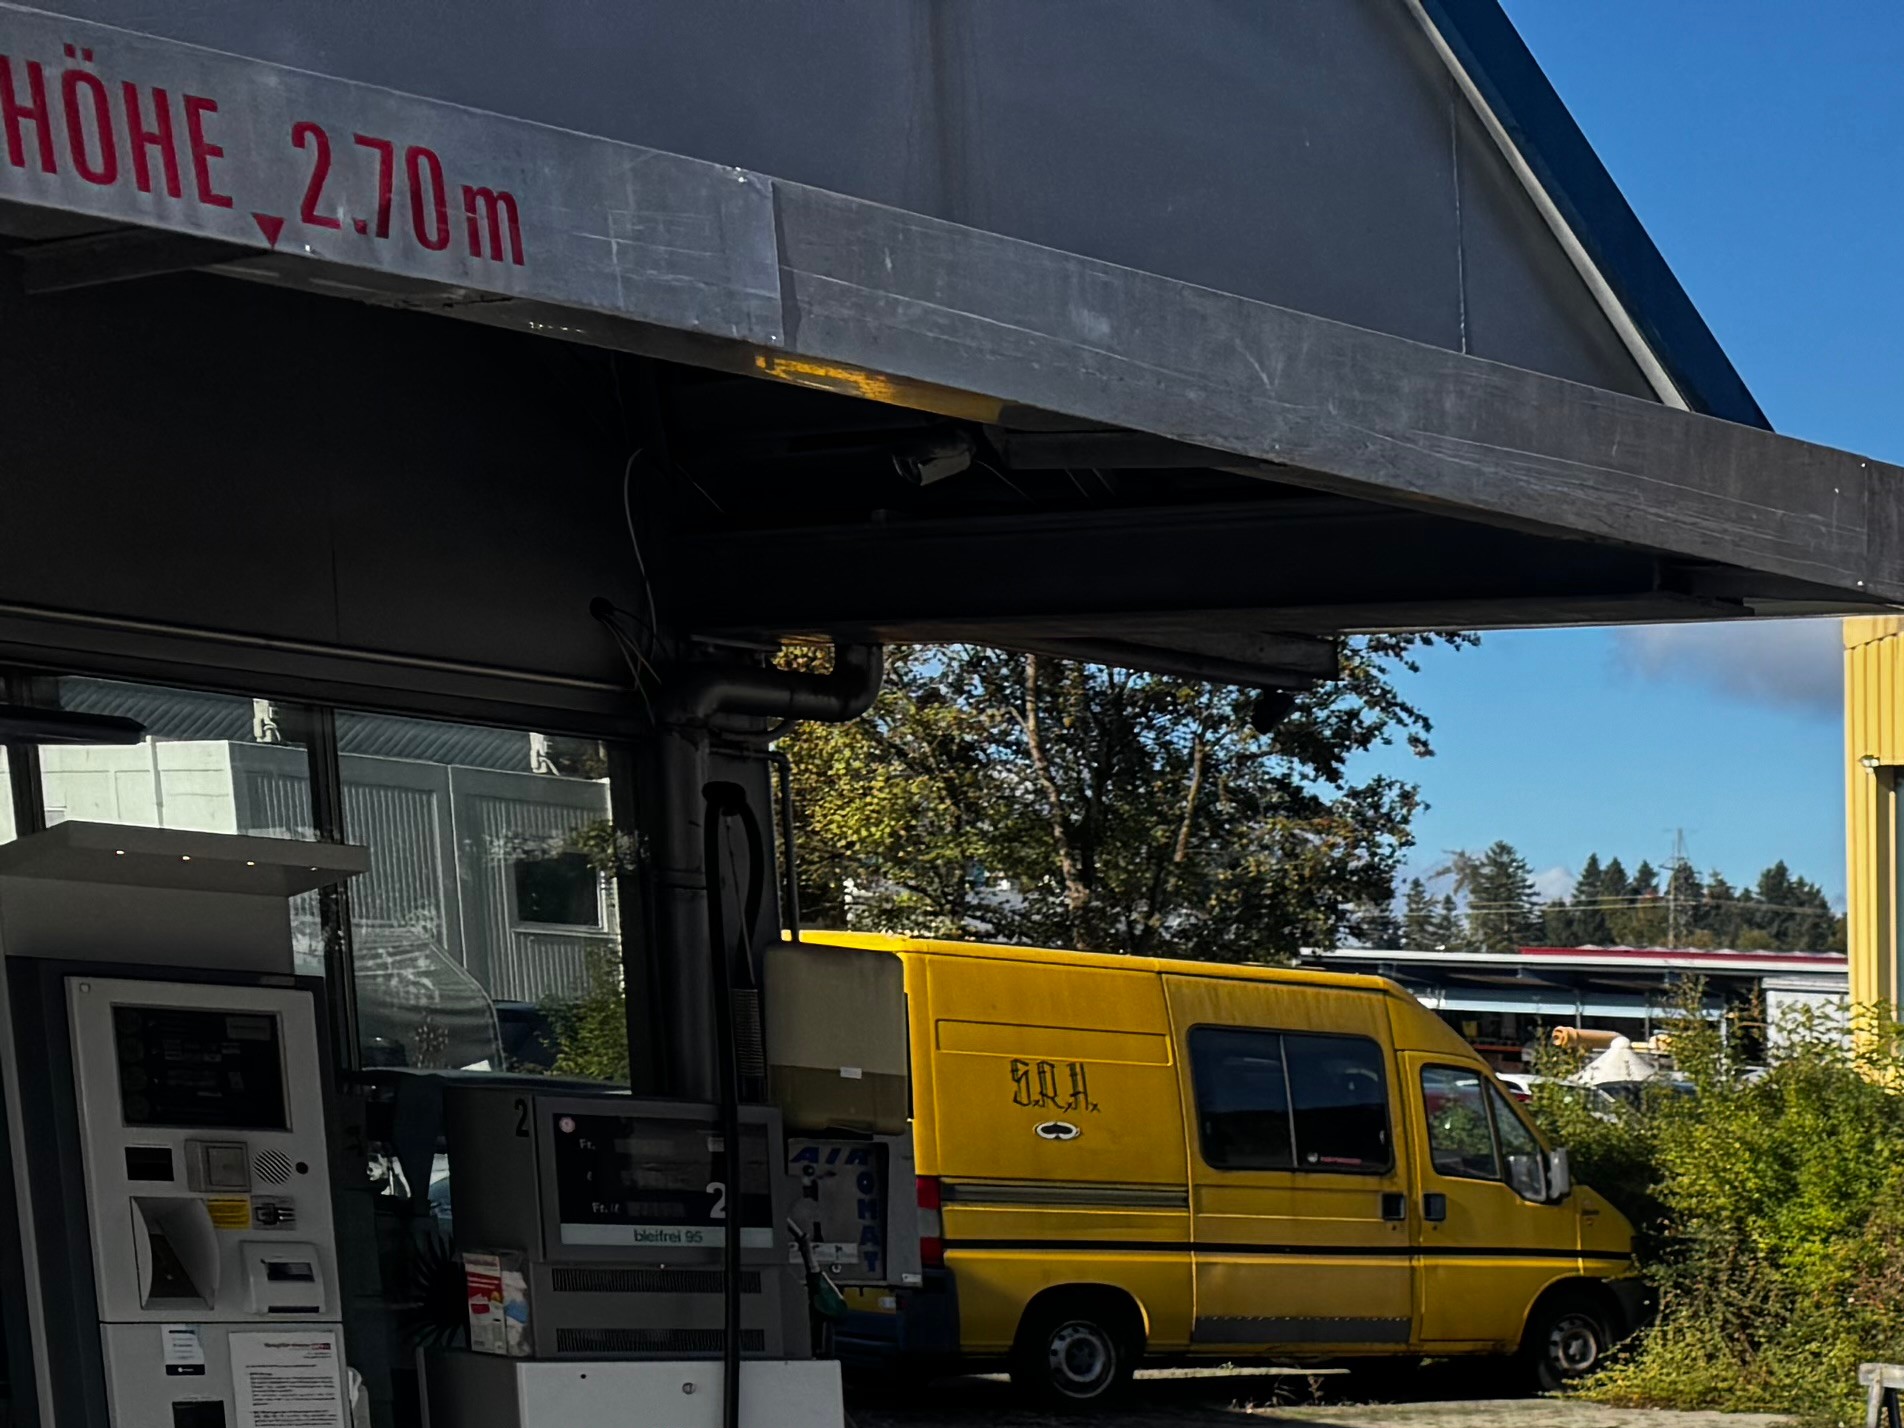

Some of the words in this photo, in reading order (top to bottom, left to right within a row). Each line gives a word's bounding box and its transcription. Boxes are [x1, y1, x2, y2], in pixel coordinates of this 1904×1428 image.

[0, 43, 233, 210] HÖHE
[513, 1097, 530, 1138] 2
[633, 1229, 682, 1243] bleifrei
[686, 1231, 704, 1243] 95
